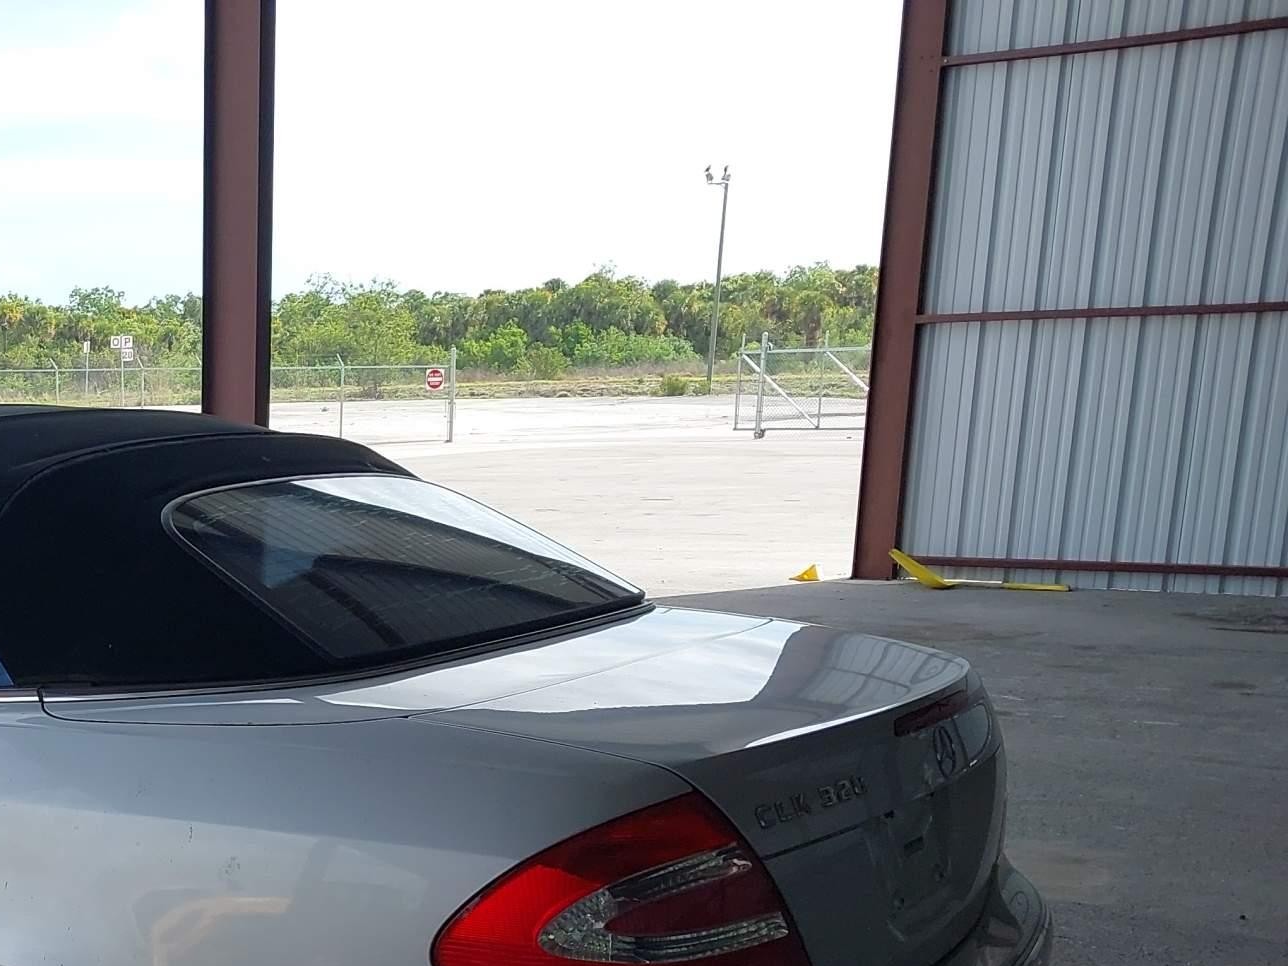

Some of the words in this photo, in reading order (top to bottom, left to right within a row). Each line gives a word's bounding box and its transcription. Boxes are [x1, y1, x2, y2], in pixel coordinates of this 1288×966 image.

[124, 337, 131, 347] P
[122, 351, 133, 360] 20
[754, 792, 811, 829] CLK
